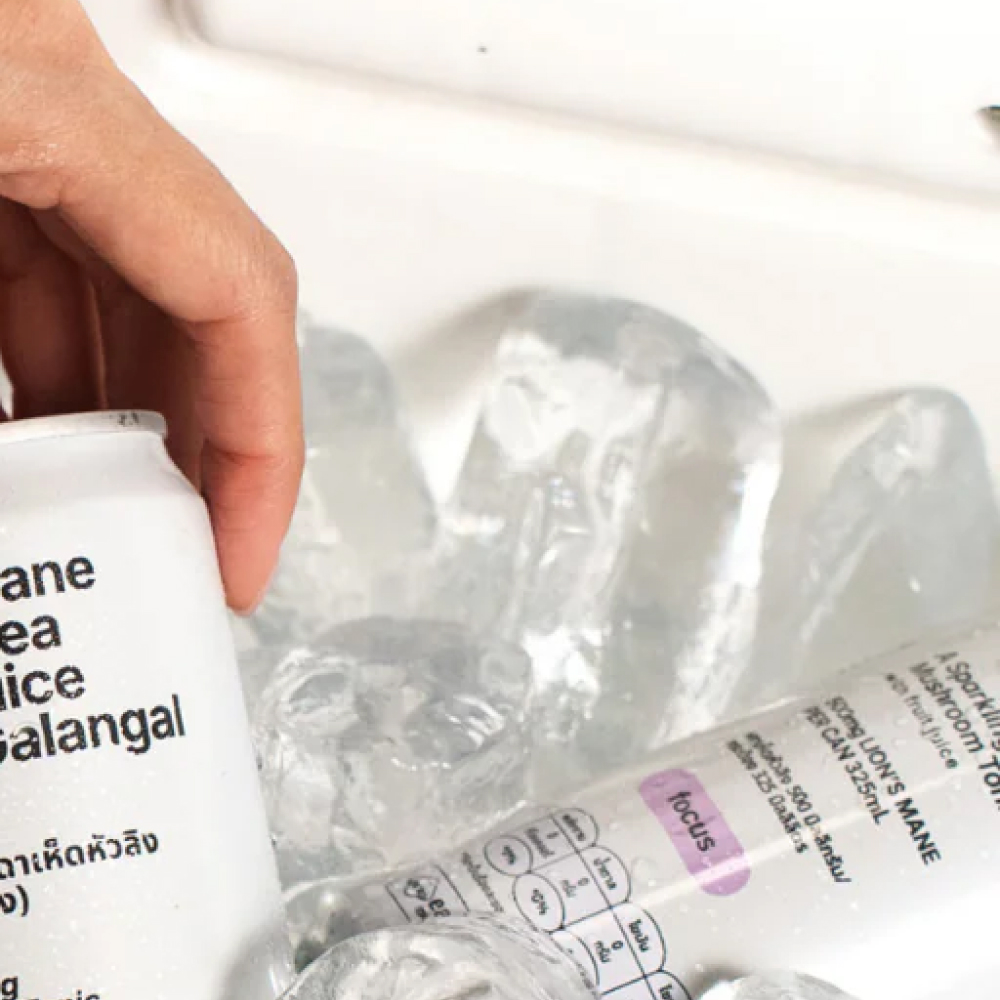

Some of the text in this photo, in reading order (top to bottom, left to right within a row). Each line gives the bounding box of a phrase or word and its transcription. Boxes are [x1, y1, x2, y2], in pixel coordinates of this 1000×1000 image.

[904, 694, 933, 725] fruit
[920, 727, 958, 769] juice
[909, 661, 984, 754] Mushroom
[667, 790, 715, 854] focus
[822, 727, 856, 761] CAN
[845, 761, 889, 825] 325mL
[859, 737, 905, 796] LION'S
[895, 797, 941, 865] MANE
